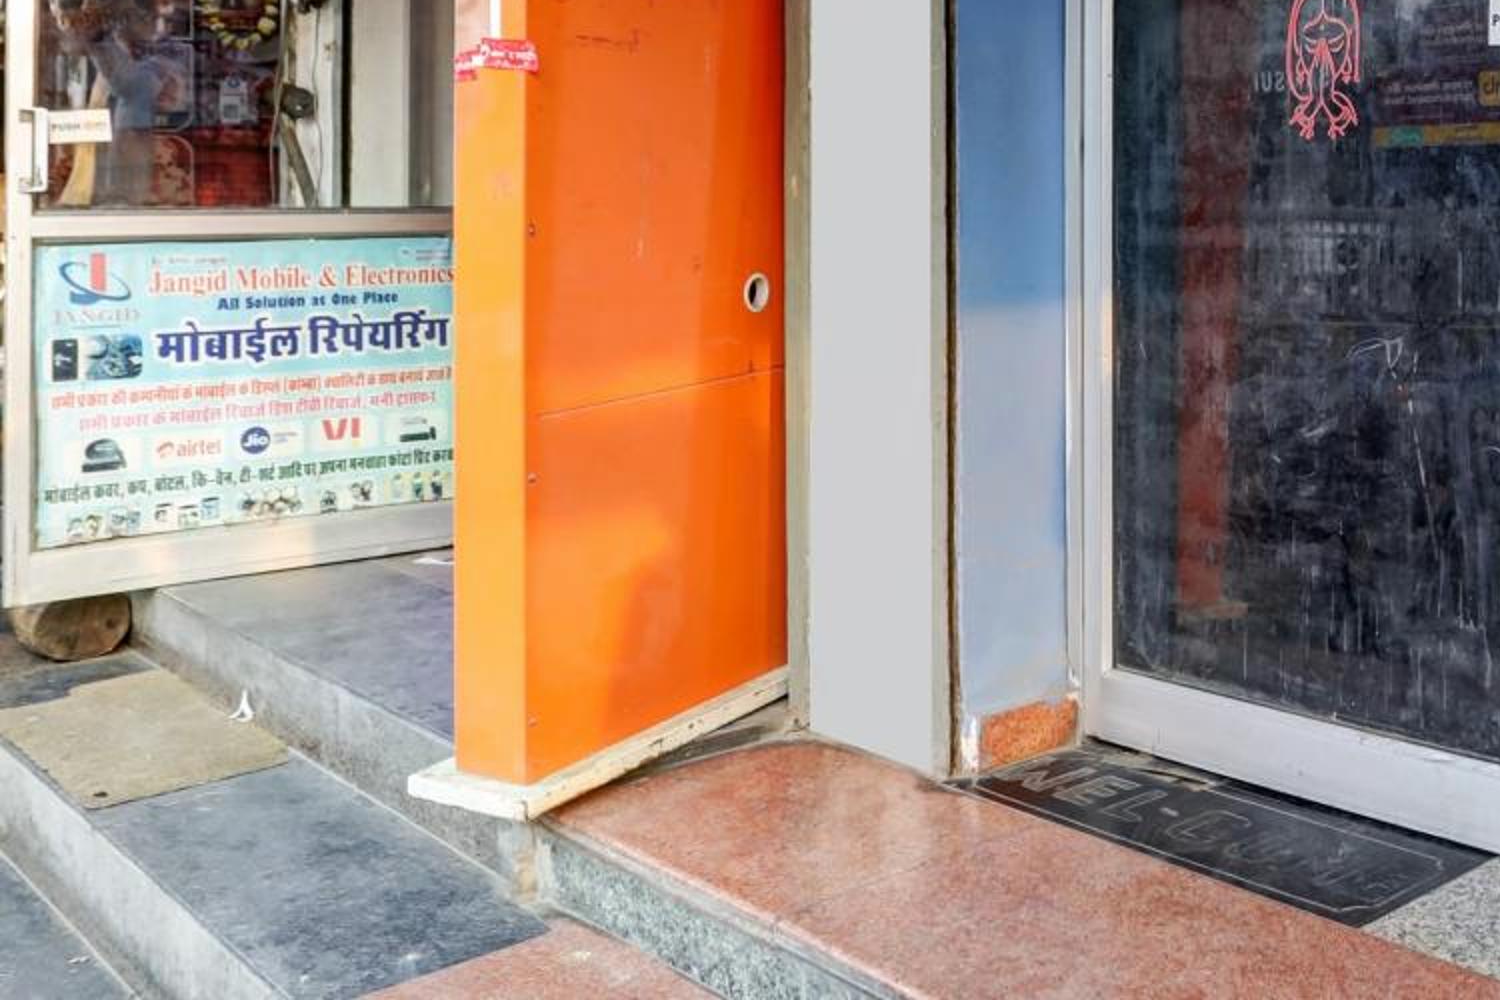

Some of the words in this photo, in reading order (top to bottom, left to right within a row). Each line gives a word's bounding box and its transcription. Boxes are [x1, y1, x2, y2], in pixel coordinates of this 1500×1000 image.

[149, 269, 227, 294] Jangid
[237, 265, 311, 290] Mobile
[319, 265, 337, 287] &
[346, 263, 455, 287] Electronics
[217, 297, 240, 311] All
[245, 296, 305, 310] Solution
[363, 291, 399, 304] Place
[156, 317, 302, 363] मोबाईल
[308, 309, 450, 354] रिपेयरिंग
[176, 439, 222, 457] airtel
